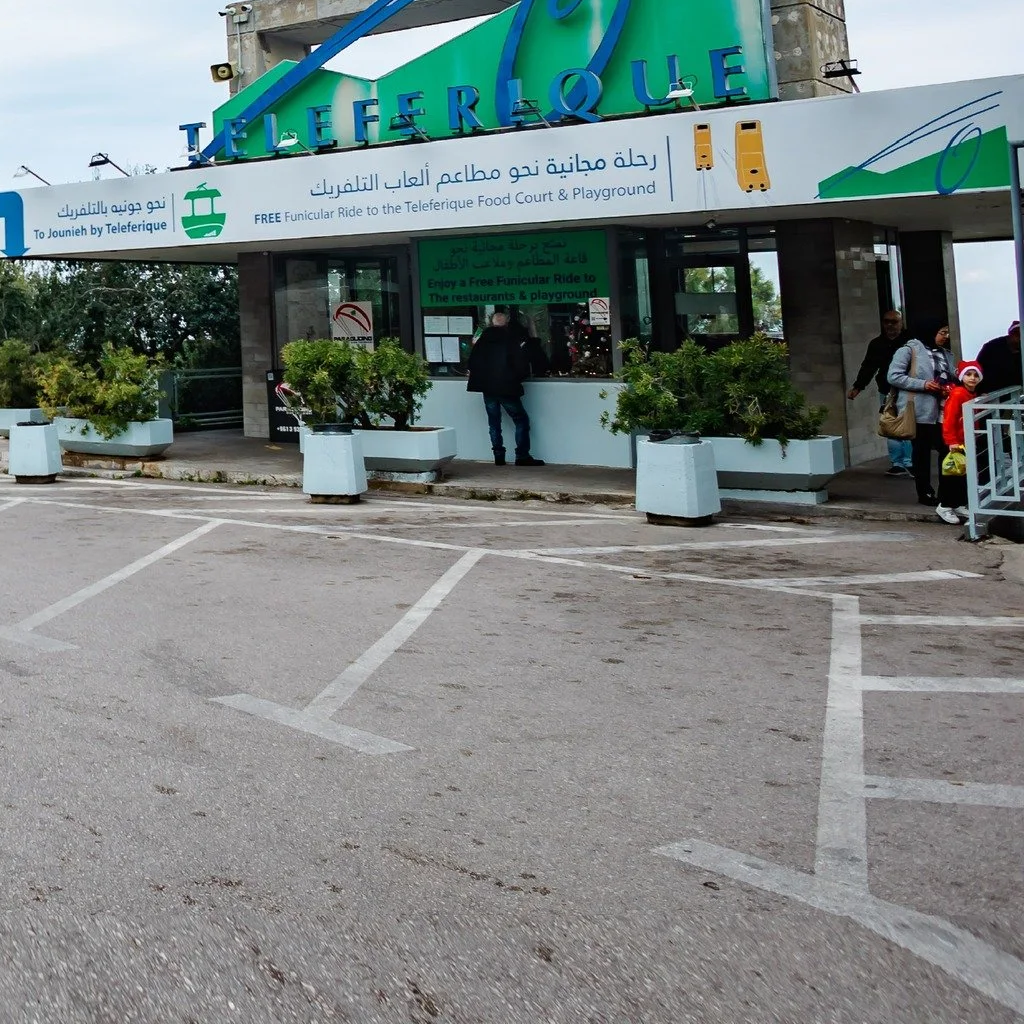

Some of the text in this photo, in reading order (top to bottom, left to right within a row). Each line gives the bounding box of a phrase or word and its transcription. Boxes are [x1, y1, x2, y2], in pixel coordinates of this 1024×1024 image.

[179, 45, 746, 167] TELEFERIQUE
[310, 148, 657, 199] رحلة مجانية نحو مطاعم ألعاب التلفريك
[57, 196, 166, 221] نحو جونيه بالتلفريك
[254, 180, 657, 225] FREE Funicular Ride to the Teleferique Food Court & Playground
[33, 220, 167, 240] To Jounieh by Teleferique
[427, 273, 596, 291] Enjoy a Free Funicular Ride to
[429, 287, 598, 304] The restaurants & playground
